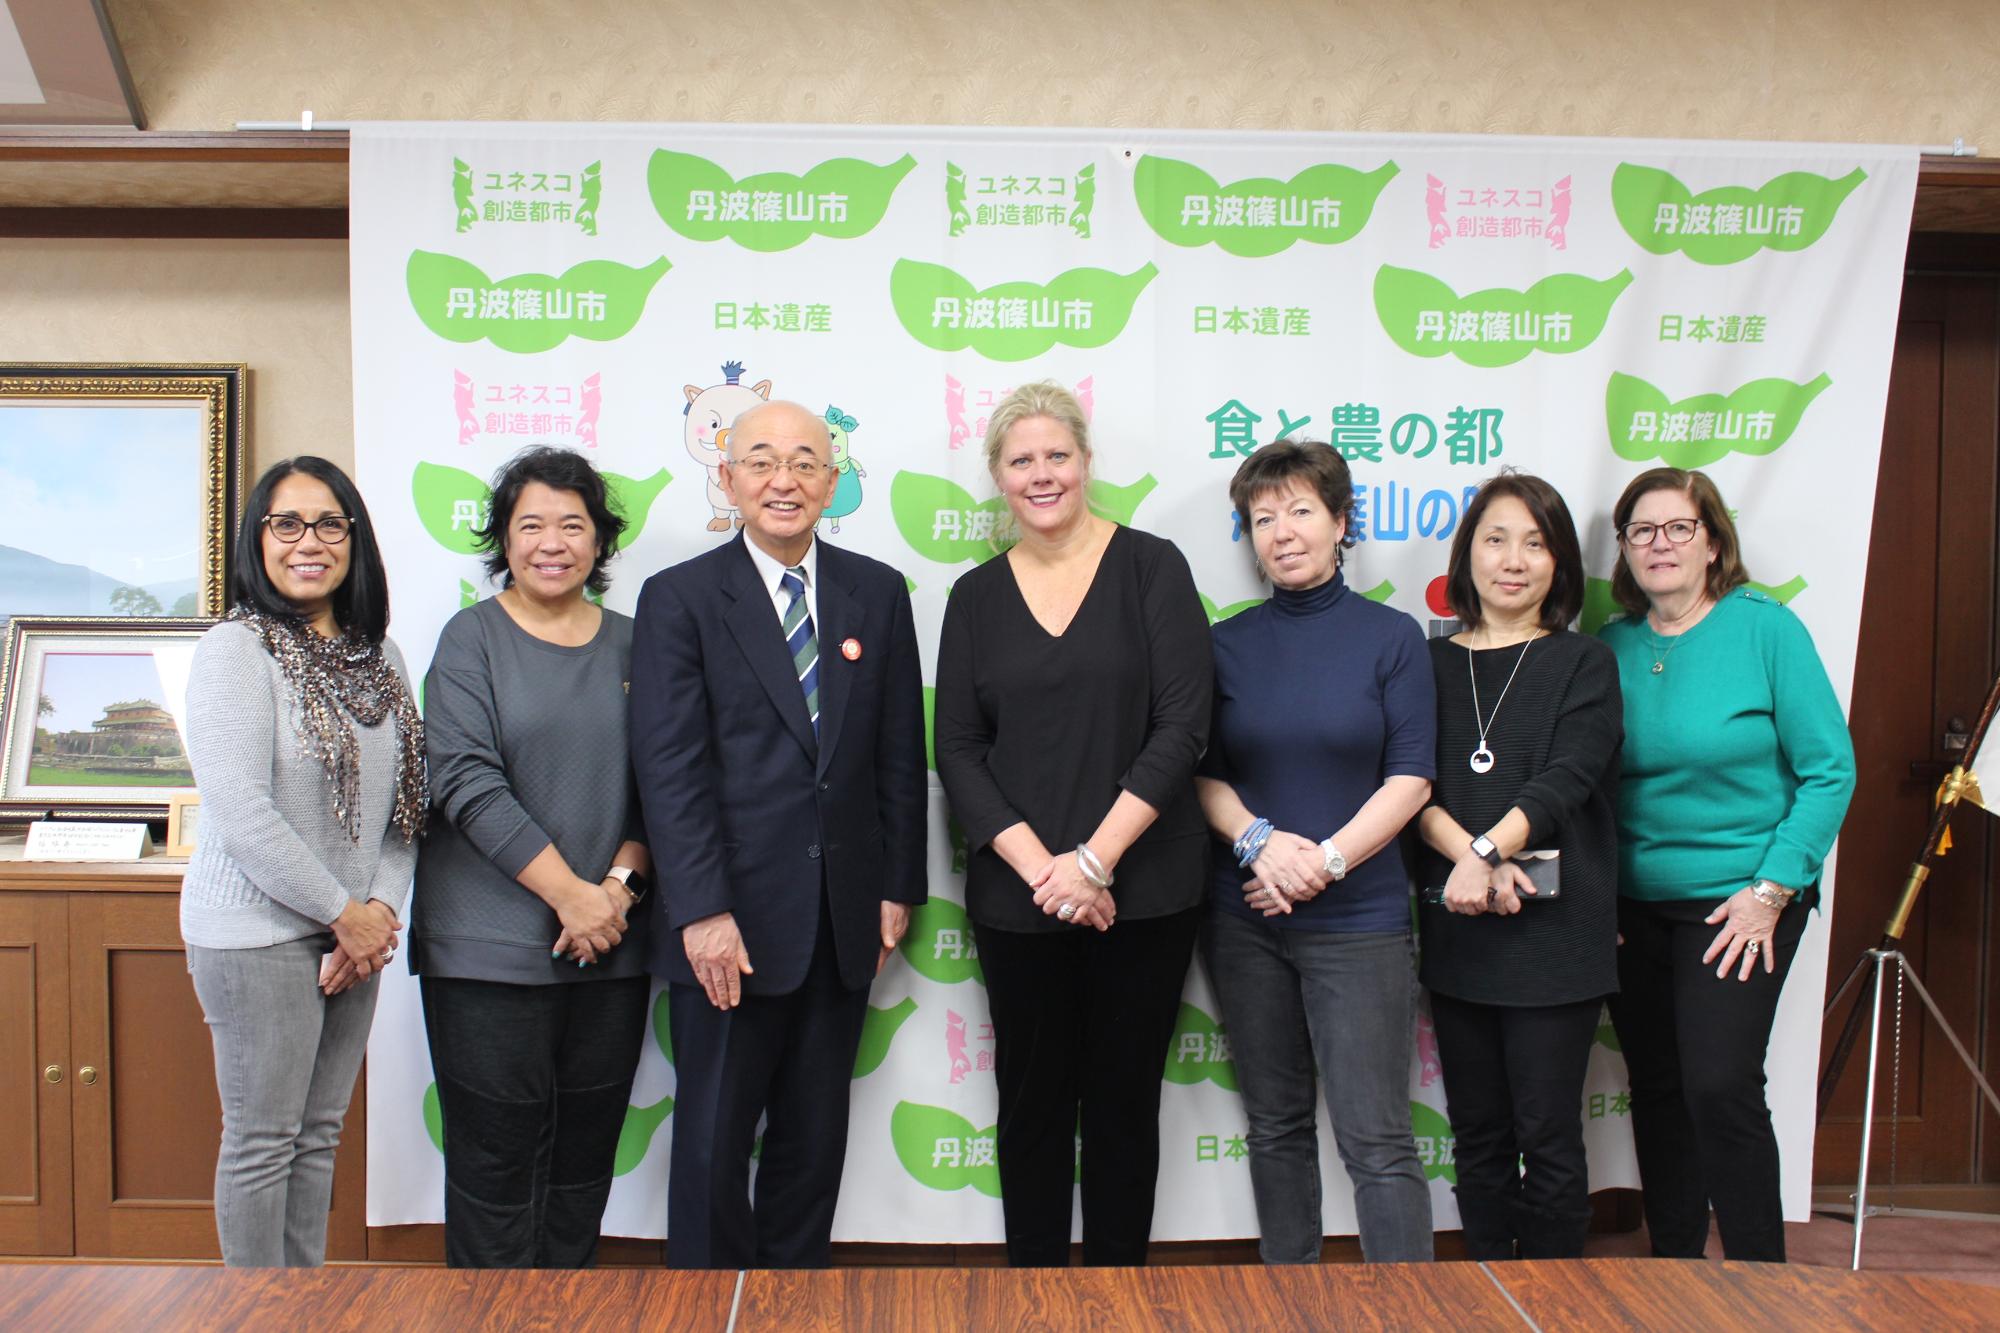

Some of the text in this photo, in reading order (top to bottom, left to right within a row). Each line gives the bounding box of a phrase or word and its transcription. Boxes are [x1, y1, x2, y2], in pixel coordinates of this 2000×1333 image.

[483, 170, 573, 193] ユネスコ
[976, 174, 1066, 196] ユネスコ
[483, 199, 573, 224] 創造都市
[686, 189, 849, 223] 丹波篠山市
[1180, 194, 1342, 229] 丹波篠山市
[1456, 188, 1543, 209] ユネスコ
[976, 203, 1067, 227] 創造都市
[1455, 214, 1544, 239] 創造都市
[1653, 202, 1804, 238] 丹波篠山市
[446, 287, 607, 323] 丹波篠山市
[714, 301, 832, 333] 日本遺産
[931, 296, 1093, 330] 丹波篠山市
[1193, 305, 1311, 337] 日本遺産
[1415, 310, 1573, 344] 丹波篠山市
[1658, 313, 1767, 344] 日本遺産
[484, 383, 573, 406] ユネスコ
[484, 411, 573, 436] 創造都市
[1205, 399, 1504, 466] 食と農の都
[1627, 408, 1776, 444] 丹波篠山市
[451, 499, 490, 531] 丹
[1588, 1091, 1632, 1121] 日本
[931, 1135, 996, 1168] 丹波
[1197, 1134, 1249, 1162] 日本
